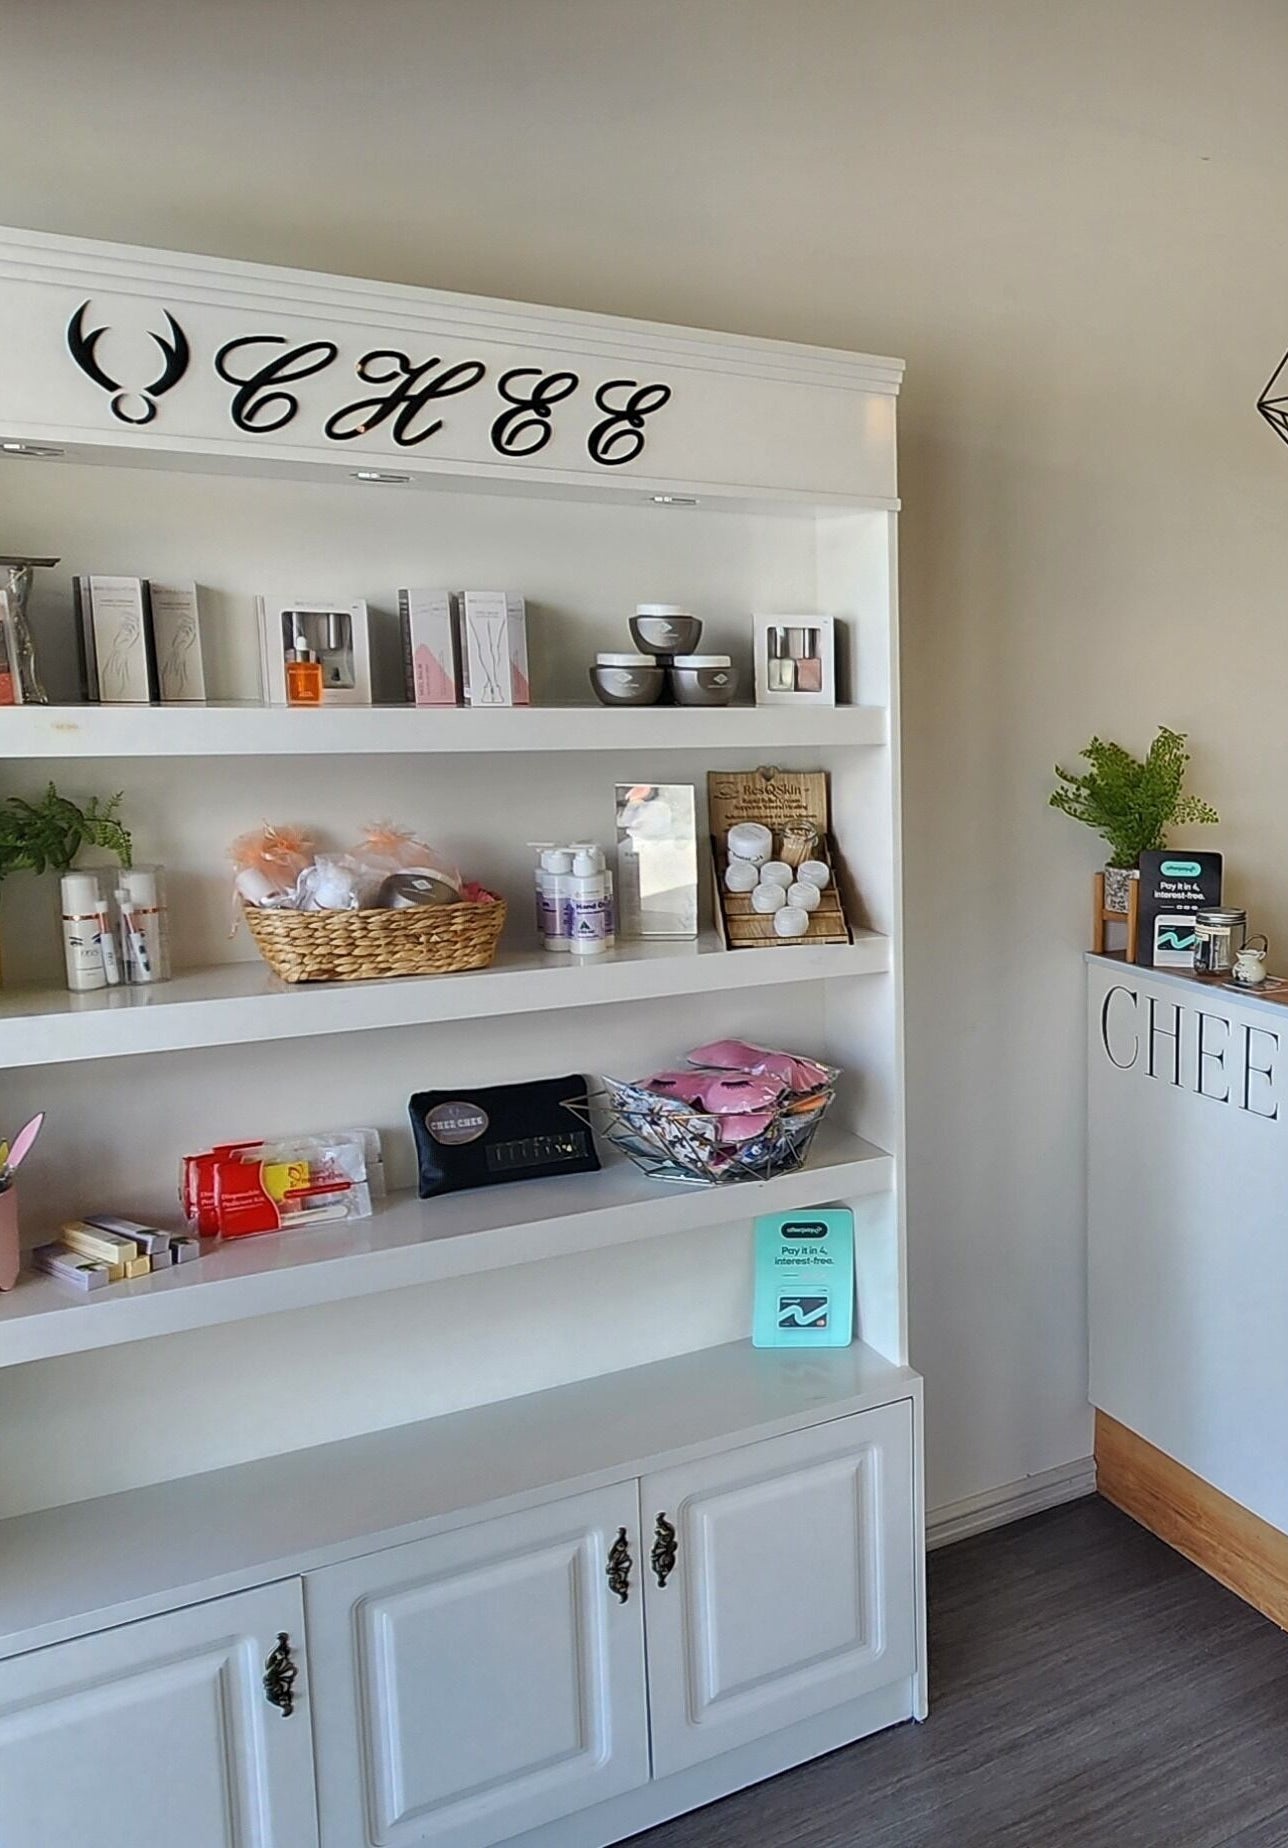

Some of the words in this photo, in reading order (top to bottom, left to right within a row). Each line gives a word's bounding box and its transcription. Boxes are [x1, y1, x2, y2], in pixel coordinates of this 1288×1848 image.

[214, 335, 671, 466] CHEE
[1160, 881, 1177, 892] Pay
[1101, 985, 1281, 1121] CHEE
[781, 1246, 799, 1257] Pay
[801, 1246, 808, 1254] it
[809, 1246, 818, 1254] in
[774, 1256, 835, 1265] interest-free.
